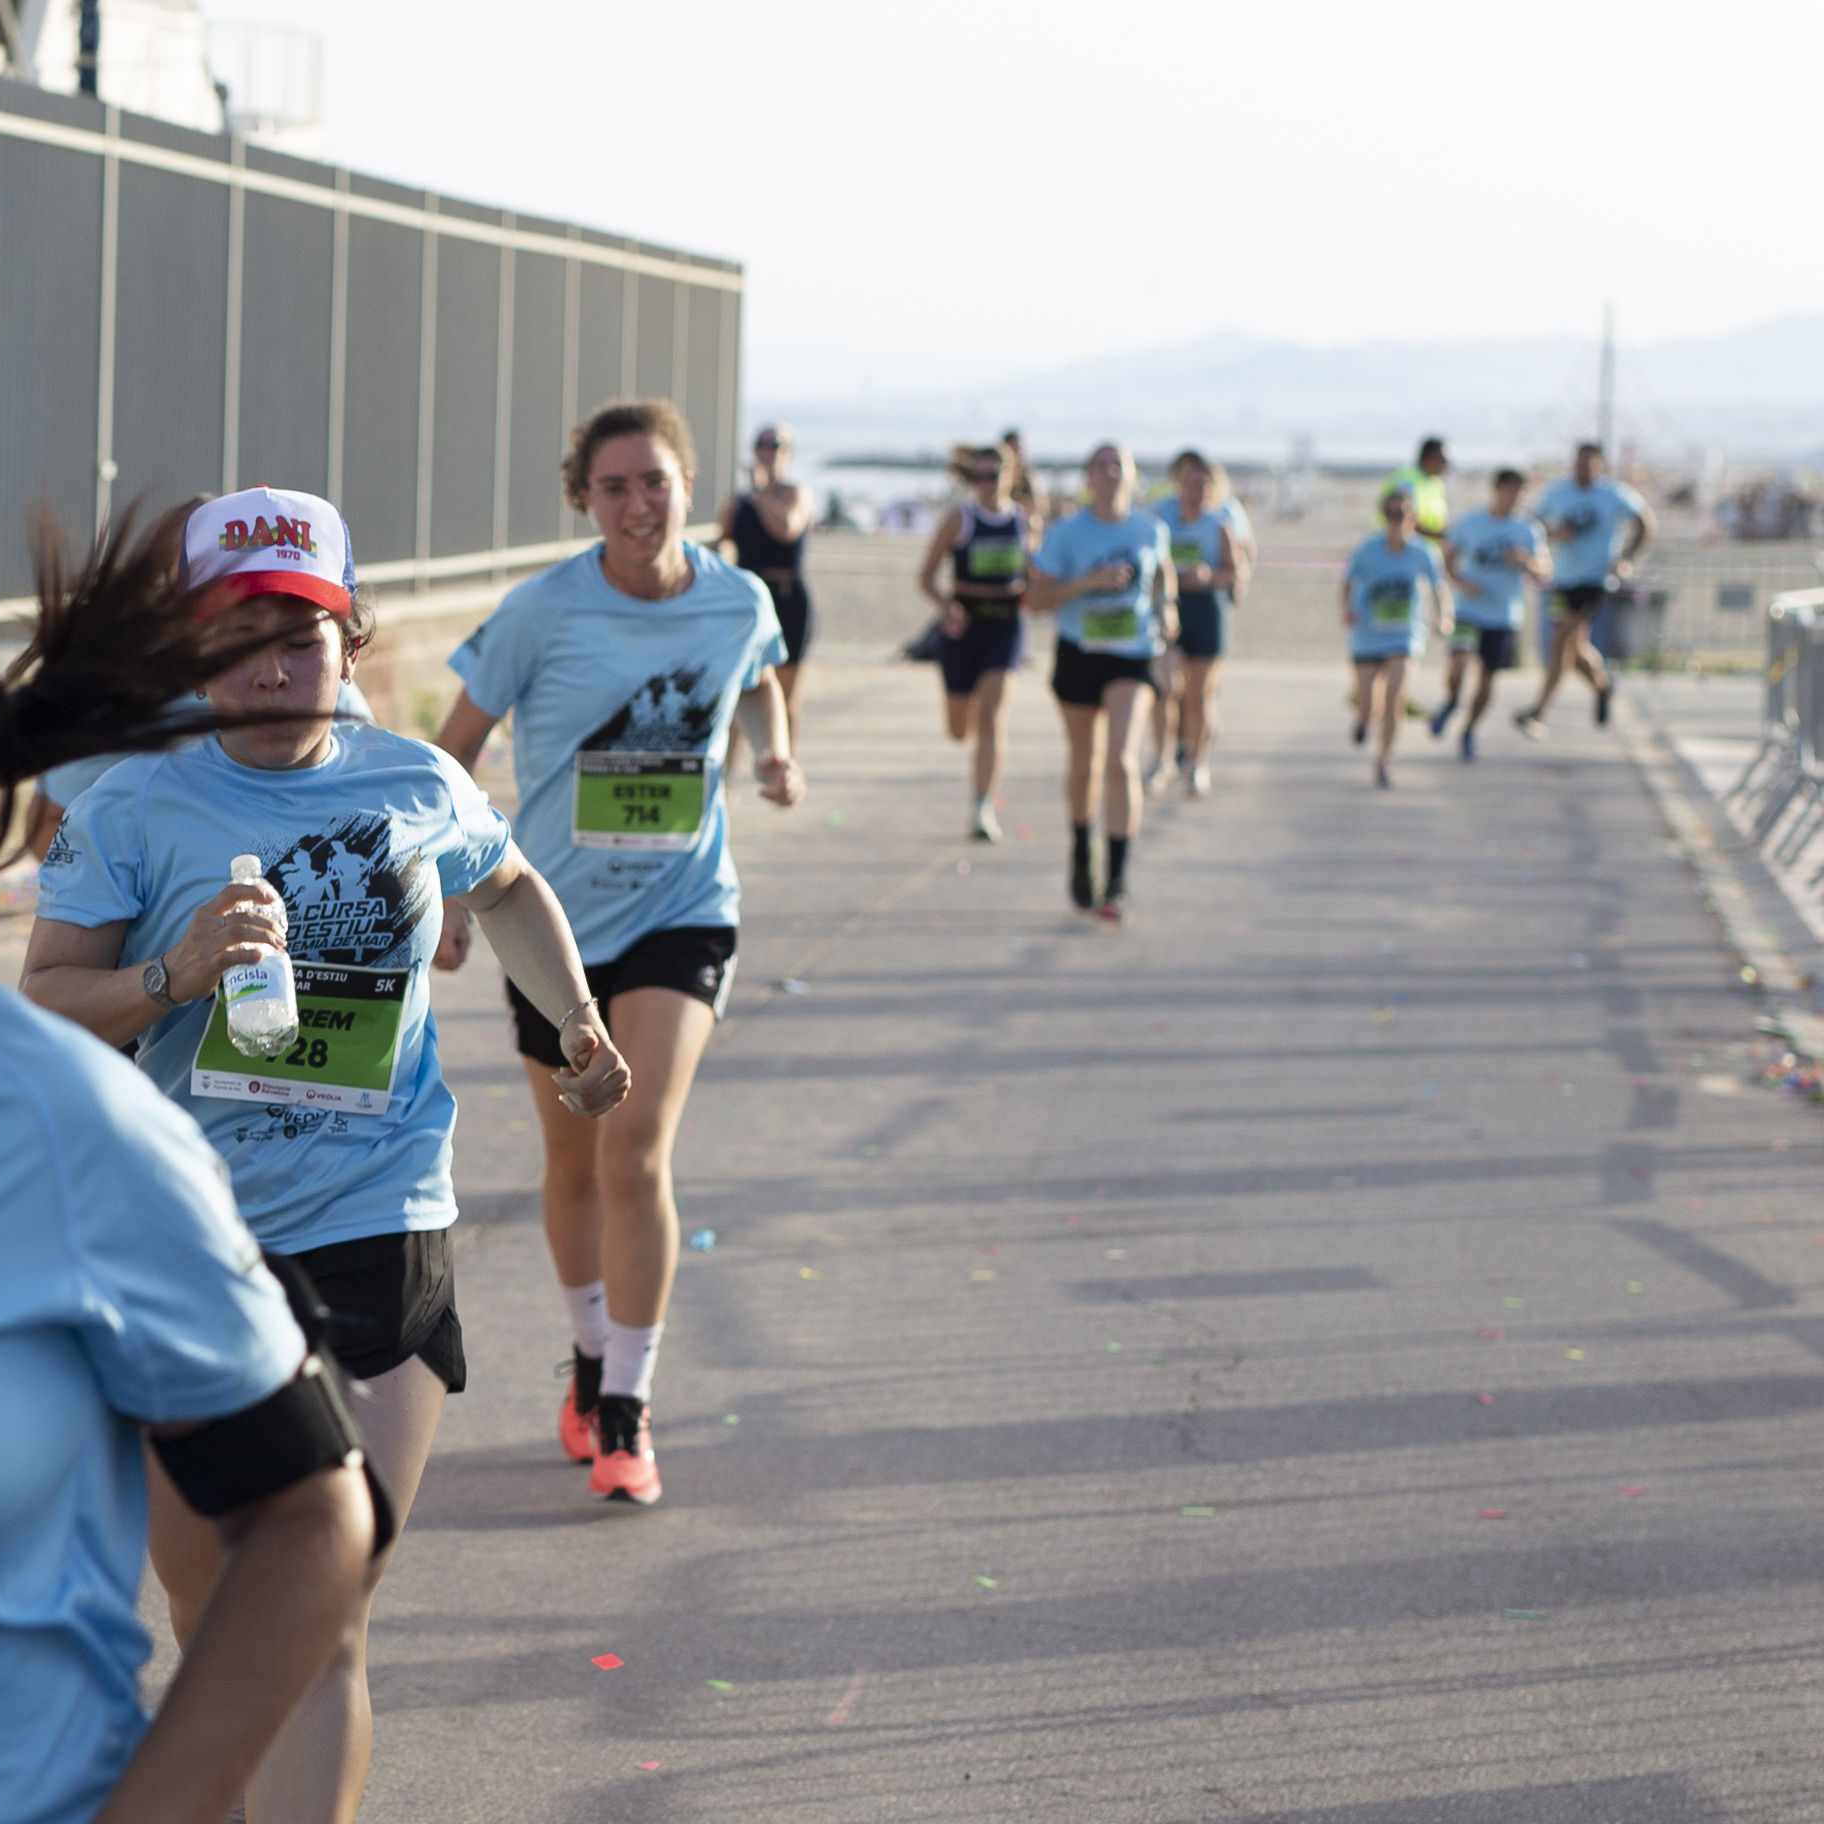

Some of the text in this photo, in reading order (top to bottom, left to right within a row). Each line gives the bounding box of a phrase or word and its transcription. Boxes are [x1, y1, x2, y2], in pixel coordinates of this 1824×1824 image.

[224, 515, 311, 552] DANI
[275, 549, 301, 561] 1970
[623, 804, 661, 826] 714
[303, 900, 384, 922] CURSA
[286, 918, 372, 941] D'ESTIU
[330, 936, 355, 948] DE
[354, 934, 391, 947] MAR
[293, 980, 311, 991] AR
[306, 970, 348, 983] D'ESTIU
[375, 978, 396, 993] 5K
[298, 1008, 355, 1031] REM
[264, 1036, 329, 1069] 28
